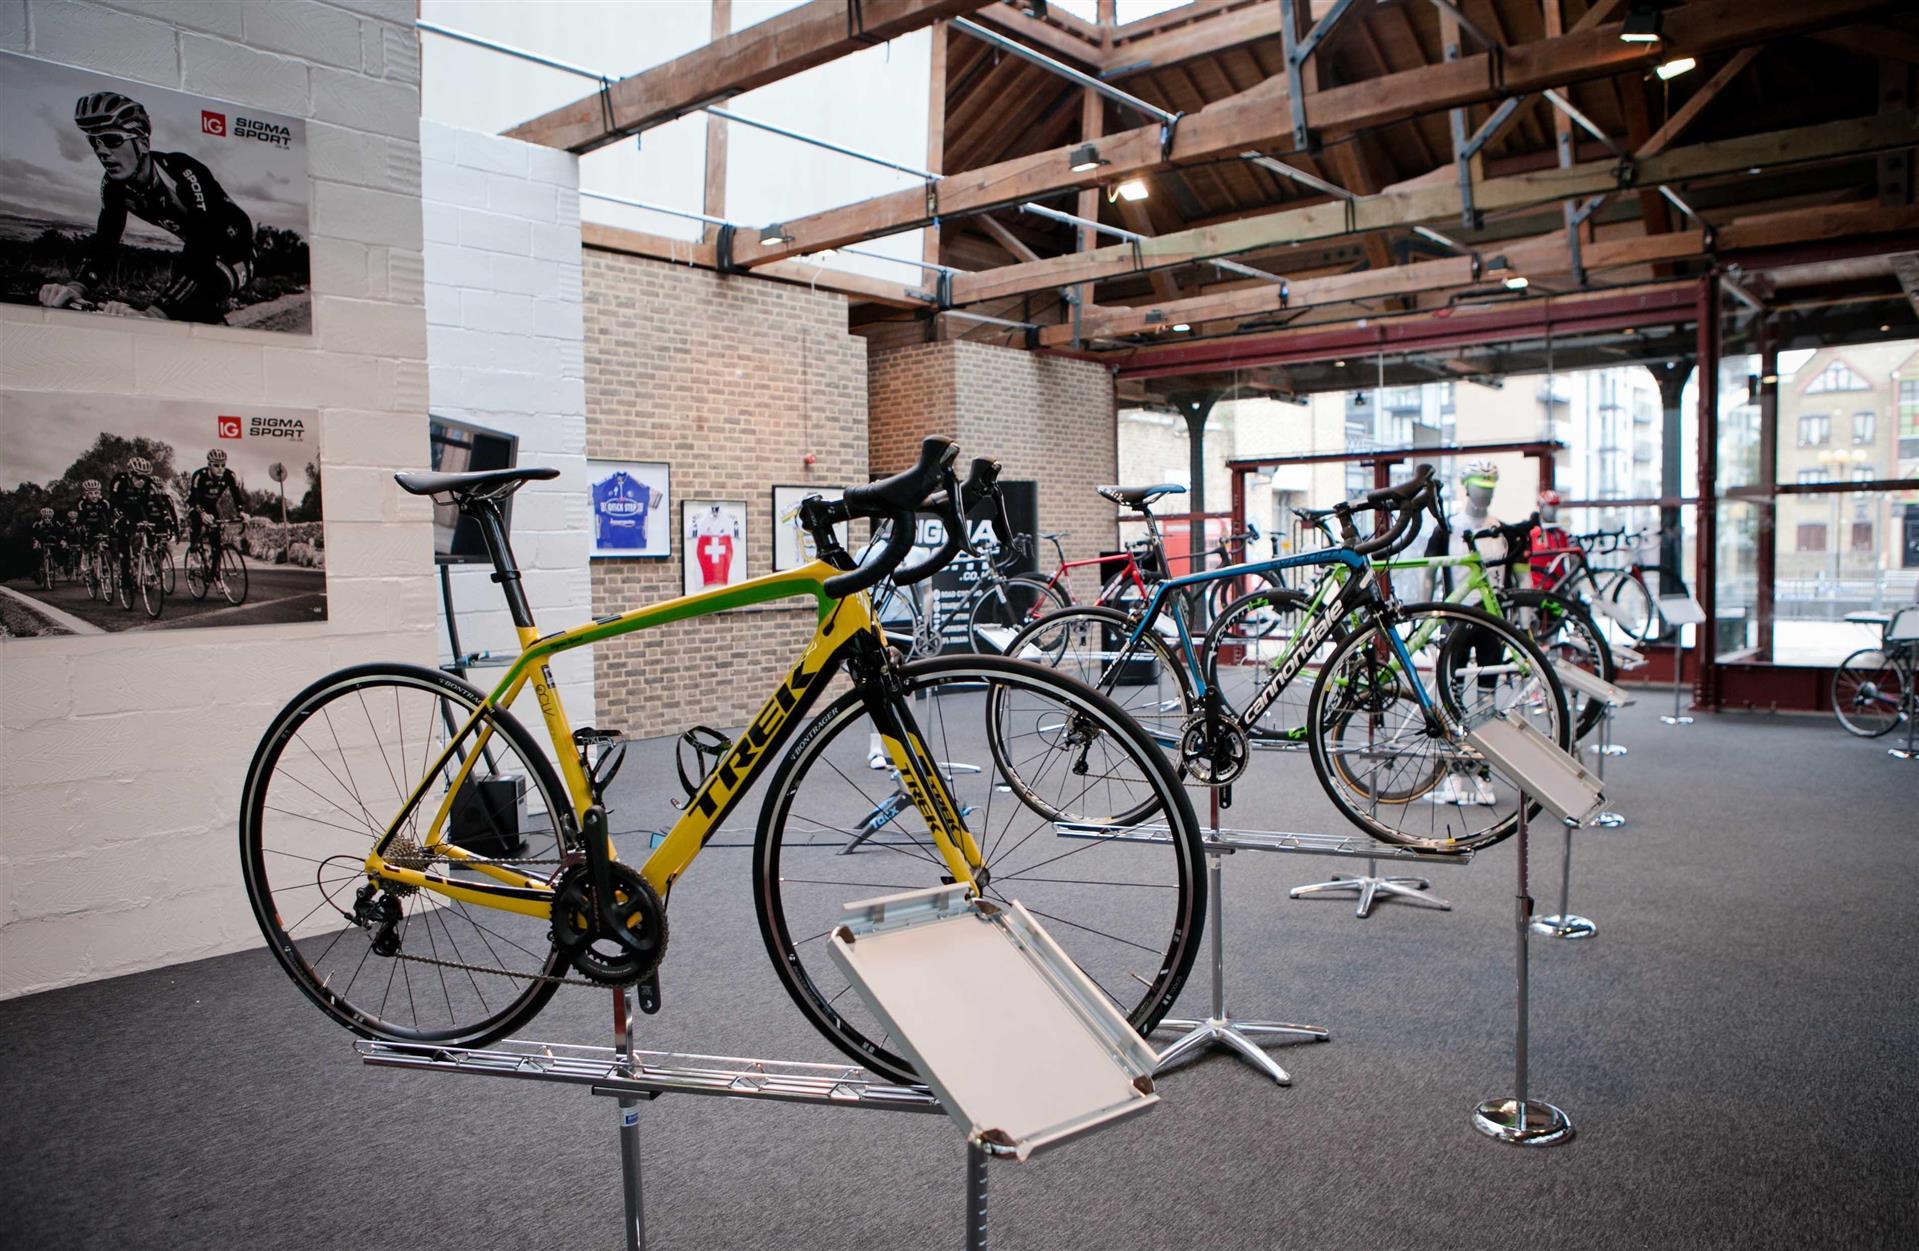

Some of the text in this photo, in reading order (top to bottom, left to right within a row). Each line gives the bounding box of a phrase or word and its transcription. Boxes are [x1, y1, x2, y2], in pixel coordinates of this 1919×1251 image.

[203, 116, 224, 134] IG
[233, 126, 292, 146] SPORT
[235, 117, 291, 137] SIGMA
[182, 168, 207, 212] SPORT
[220, 421, 240, 437] IG
[249, 427, 305, 438] SPORT
[251, 416, 304, 428] SIGMA
[1244, 599, 1345, 726] cannondale
[688, 659, 818, 819] TREK
[794, 706, 840, 757] BONTRAGER
[900, 762, 943, 834] TREK
[929, 776, 961, 833] TREK
